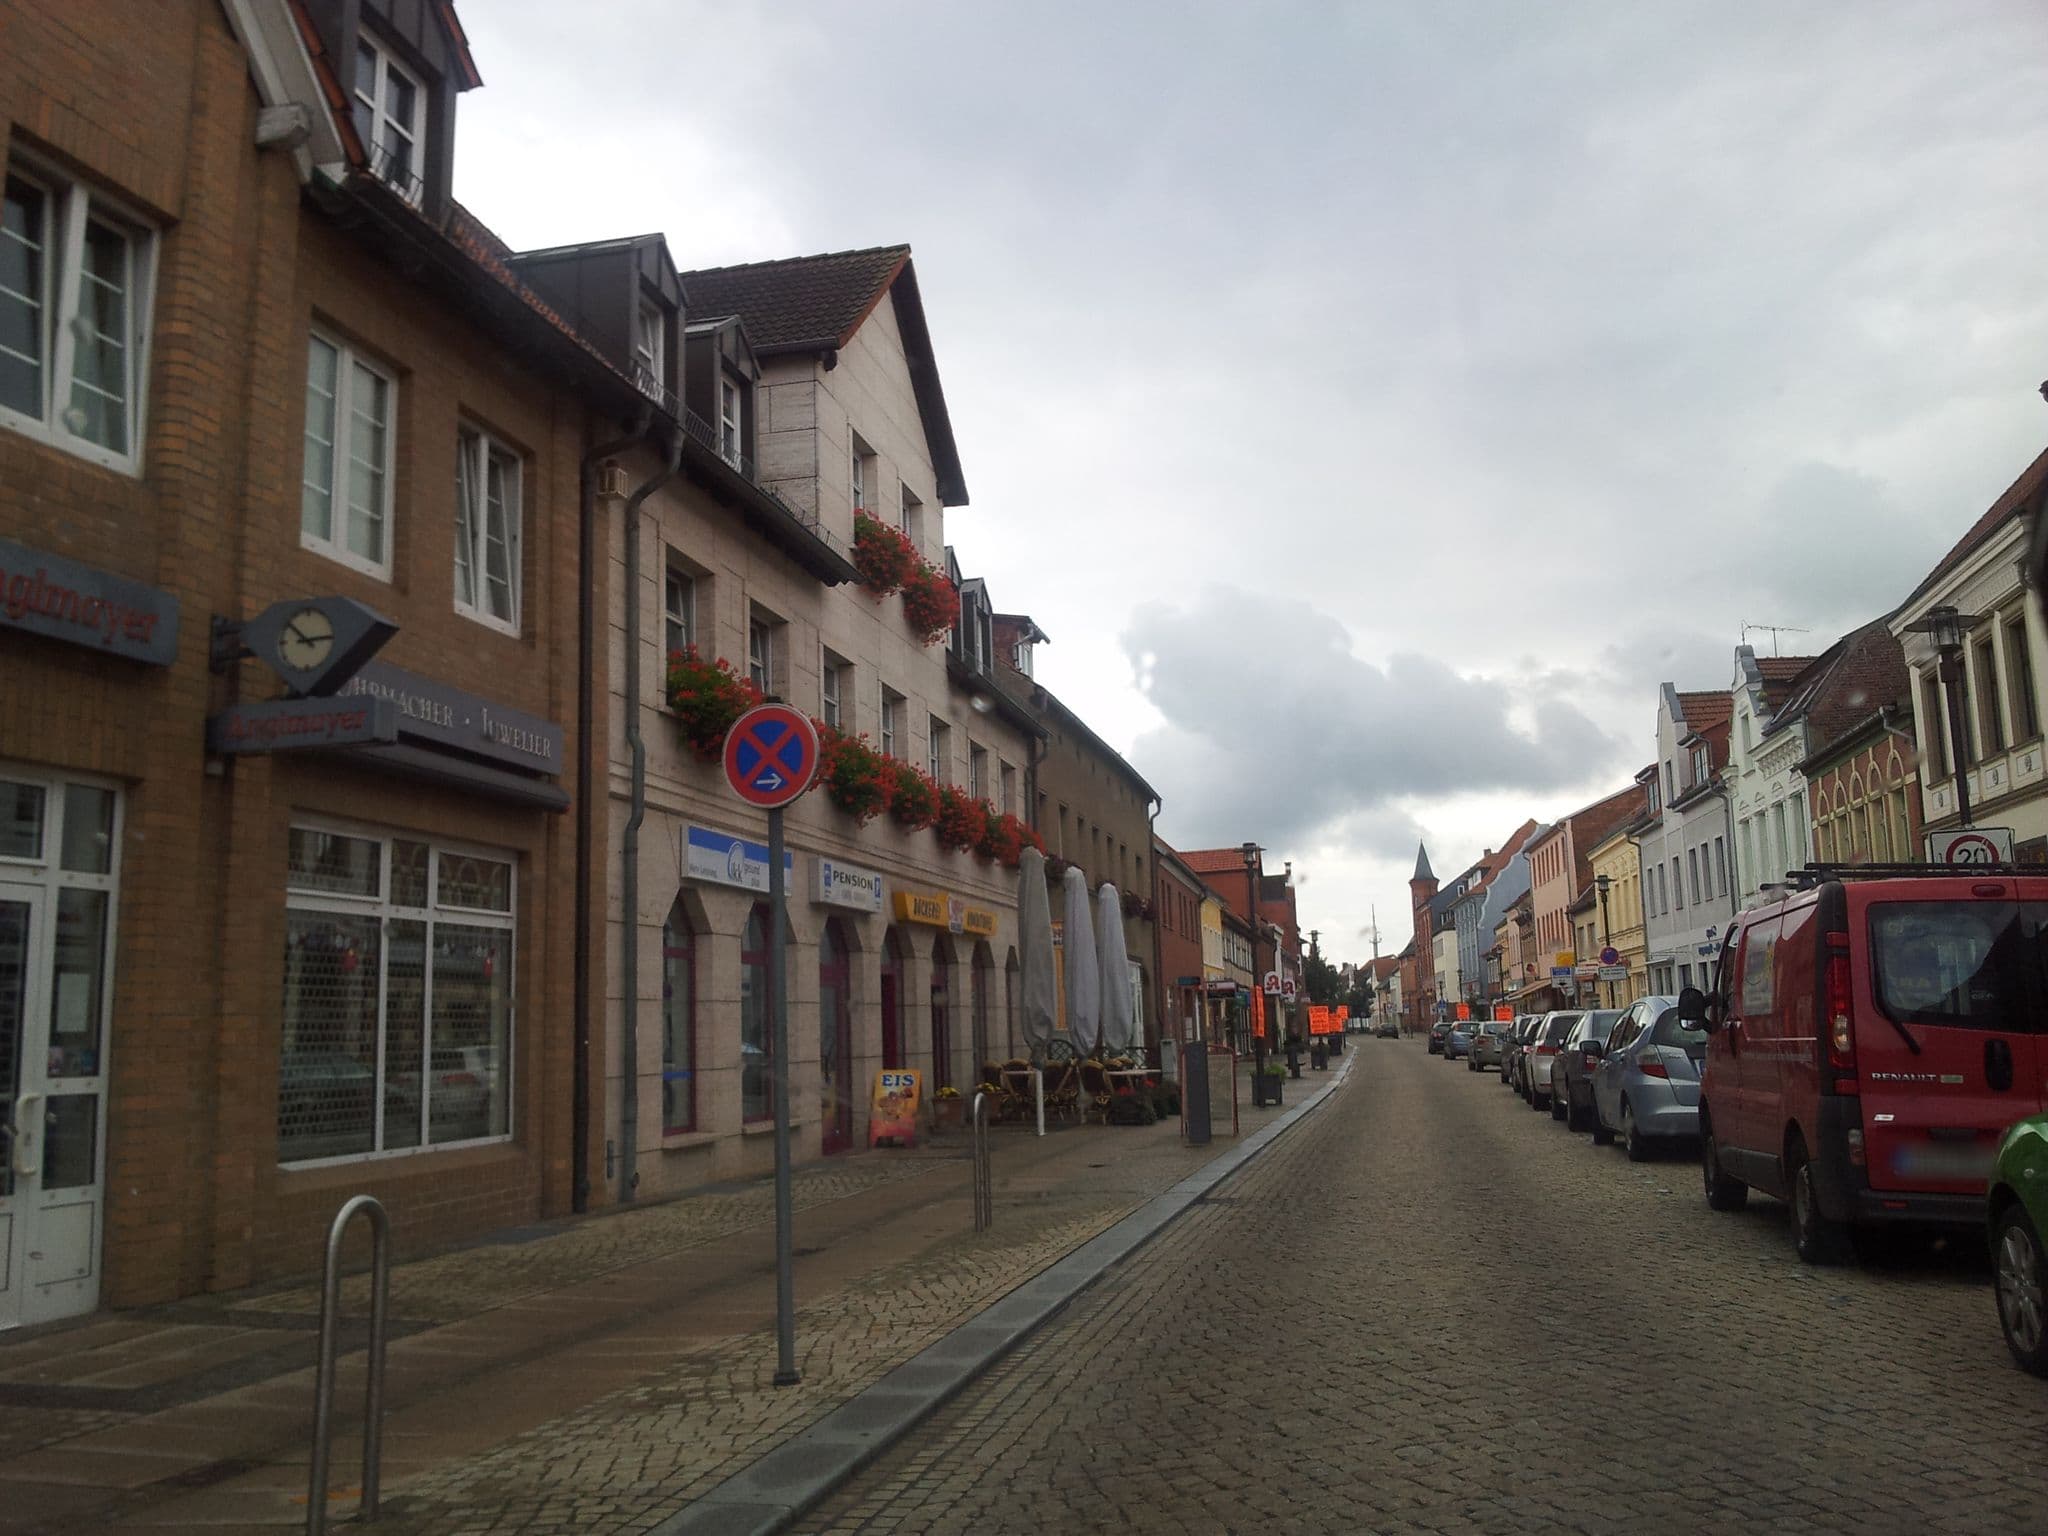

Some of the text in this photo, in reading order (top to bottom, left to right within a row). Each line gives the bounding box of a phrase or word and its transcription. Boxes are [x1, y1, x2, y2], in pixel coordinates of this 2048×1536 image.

[833, 870, 873, 891] PENSION
[882, 1074, 914, 1087] EIS
[1871, 1071, 1937, 1081] RENAULT
